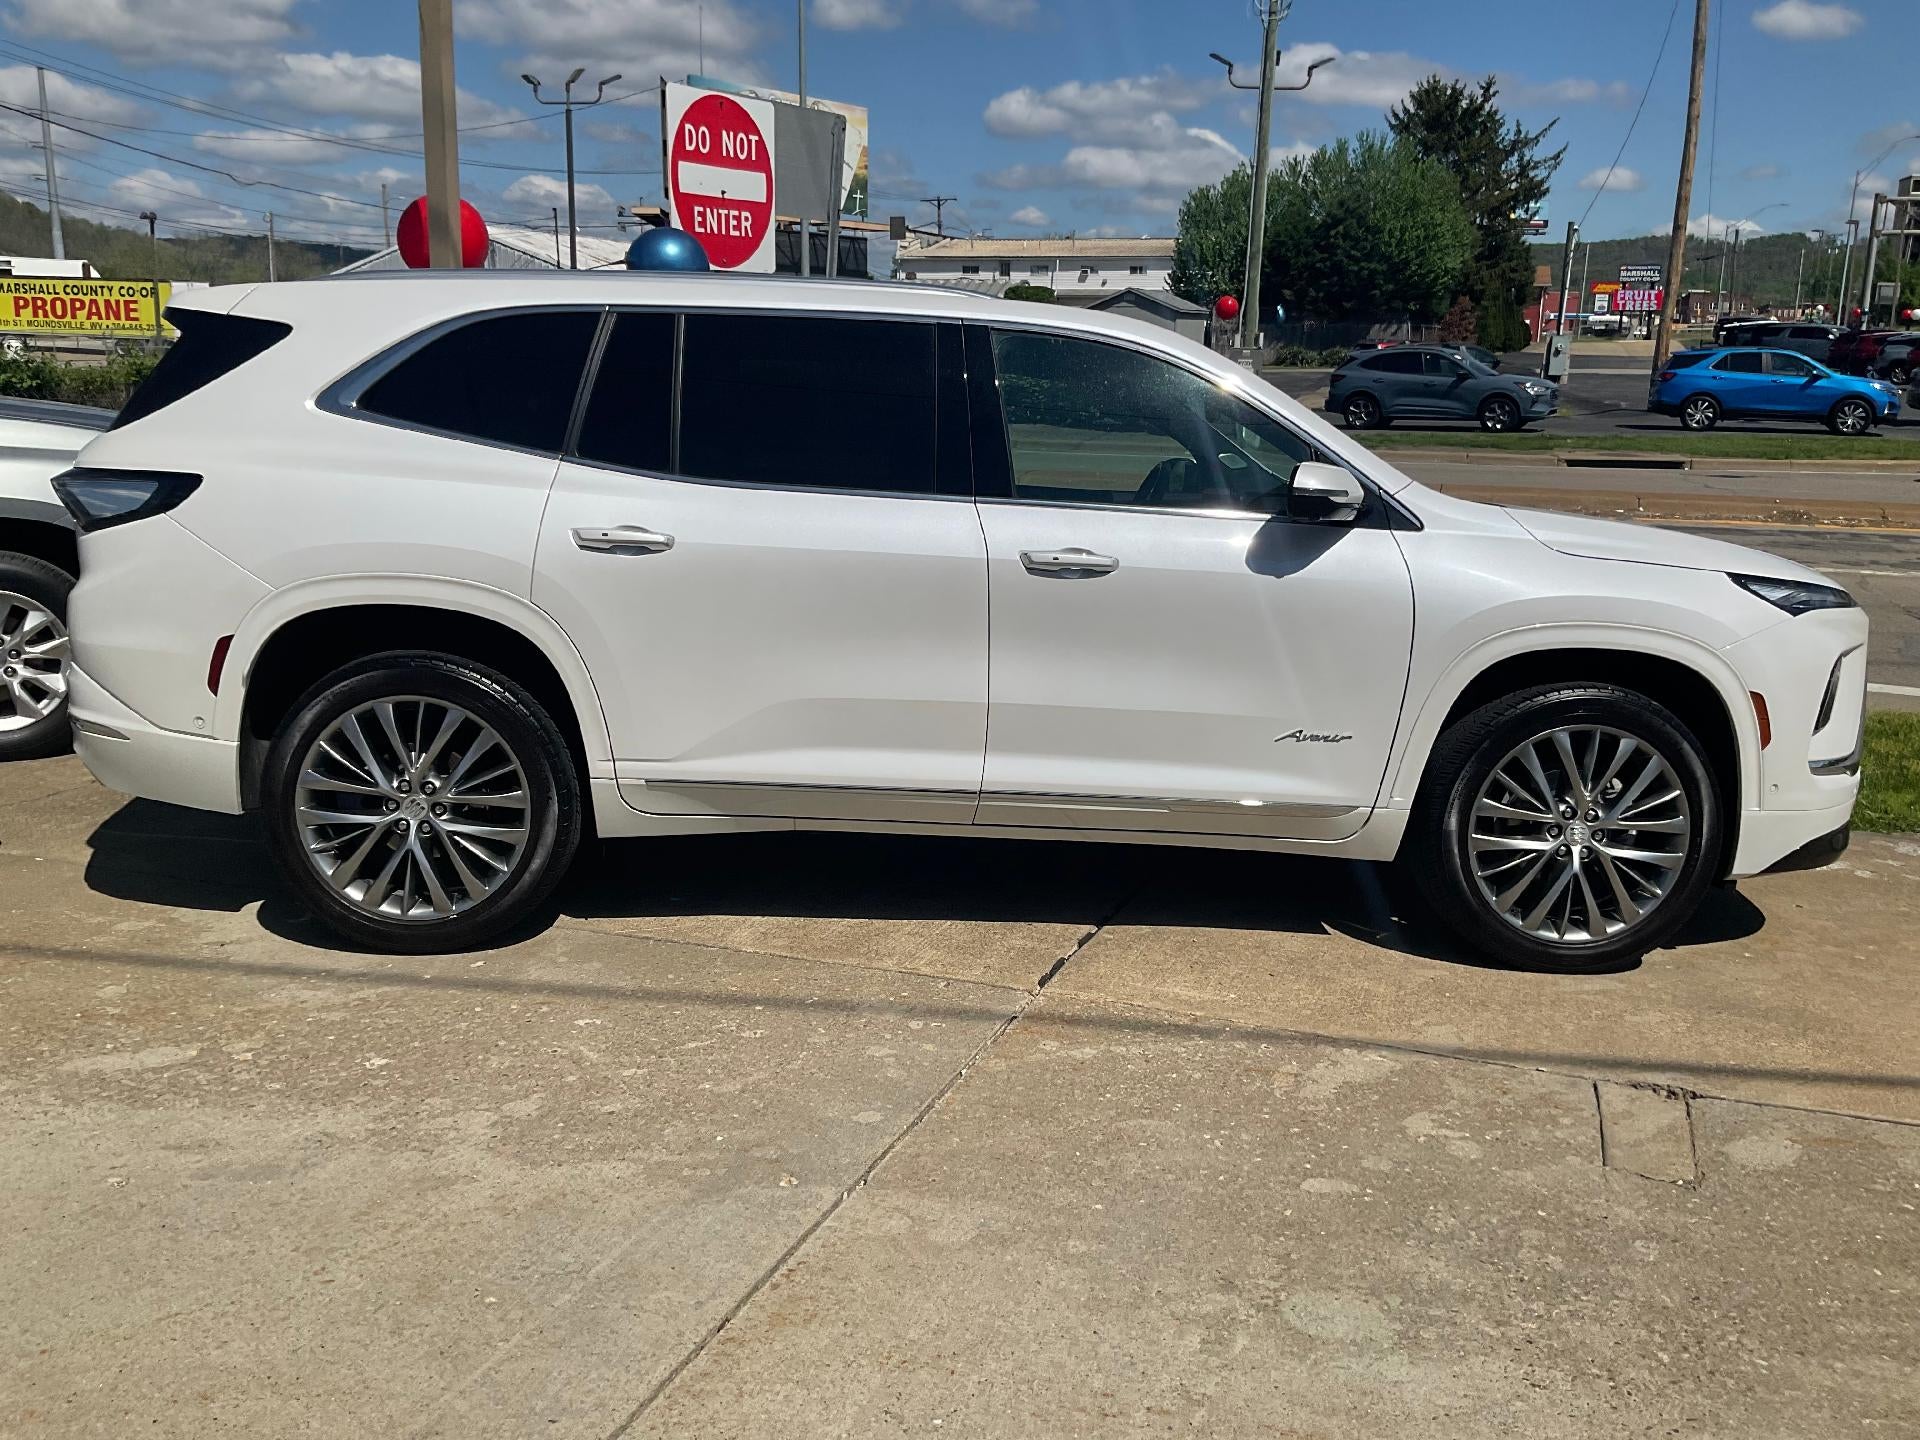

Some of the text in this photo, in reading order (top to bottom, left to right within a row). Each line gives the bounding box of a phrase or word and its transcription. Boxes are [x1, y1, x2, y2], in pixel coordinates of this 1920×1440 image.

[684, 123, 759, 161] DO NOT
[693, 206, 753, 238] ENTER
[63, 284, 114, 297] COUNTY
[1617, 289, 1658, 301] FRUIT
[13, 295, 140, 322] PROPANE
[1617, 300, 1657, 311] TREES
[89, 321, 103, 330] WV
